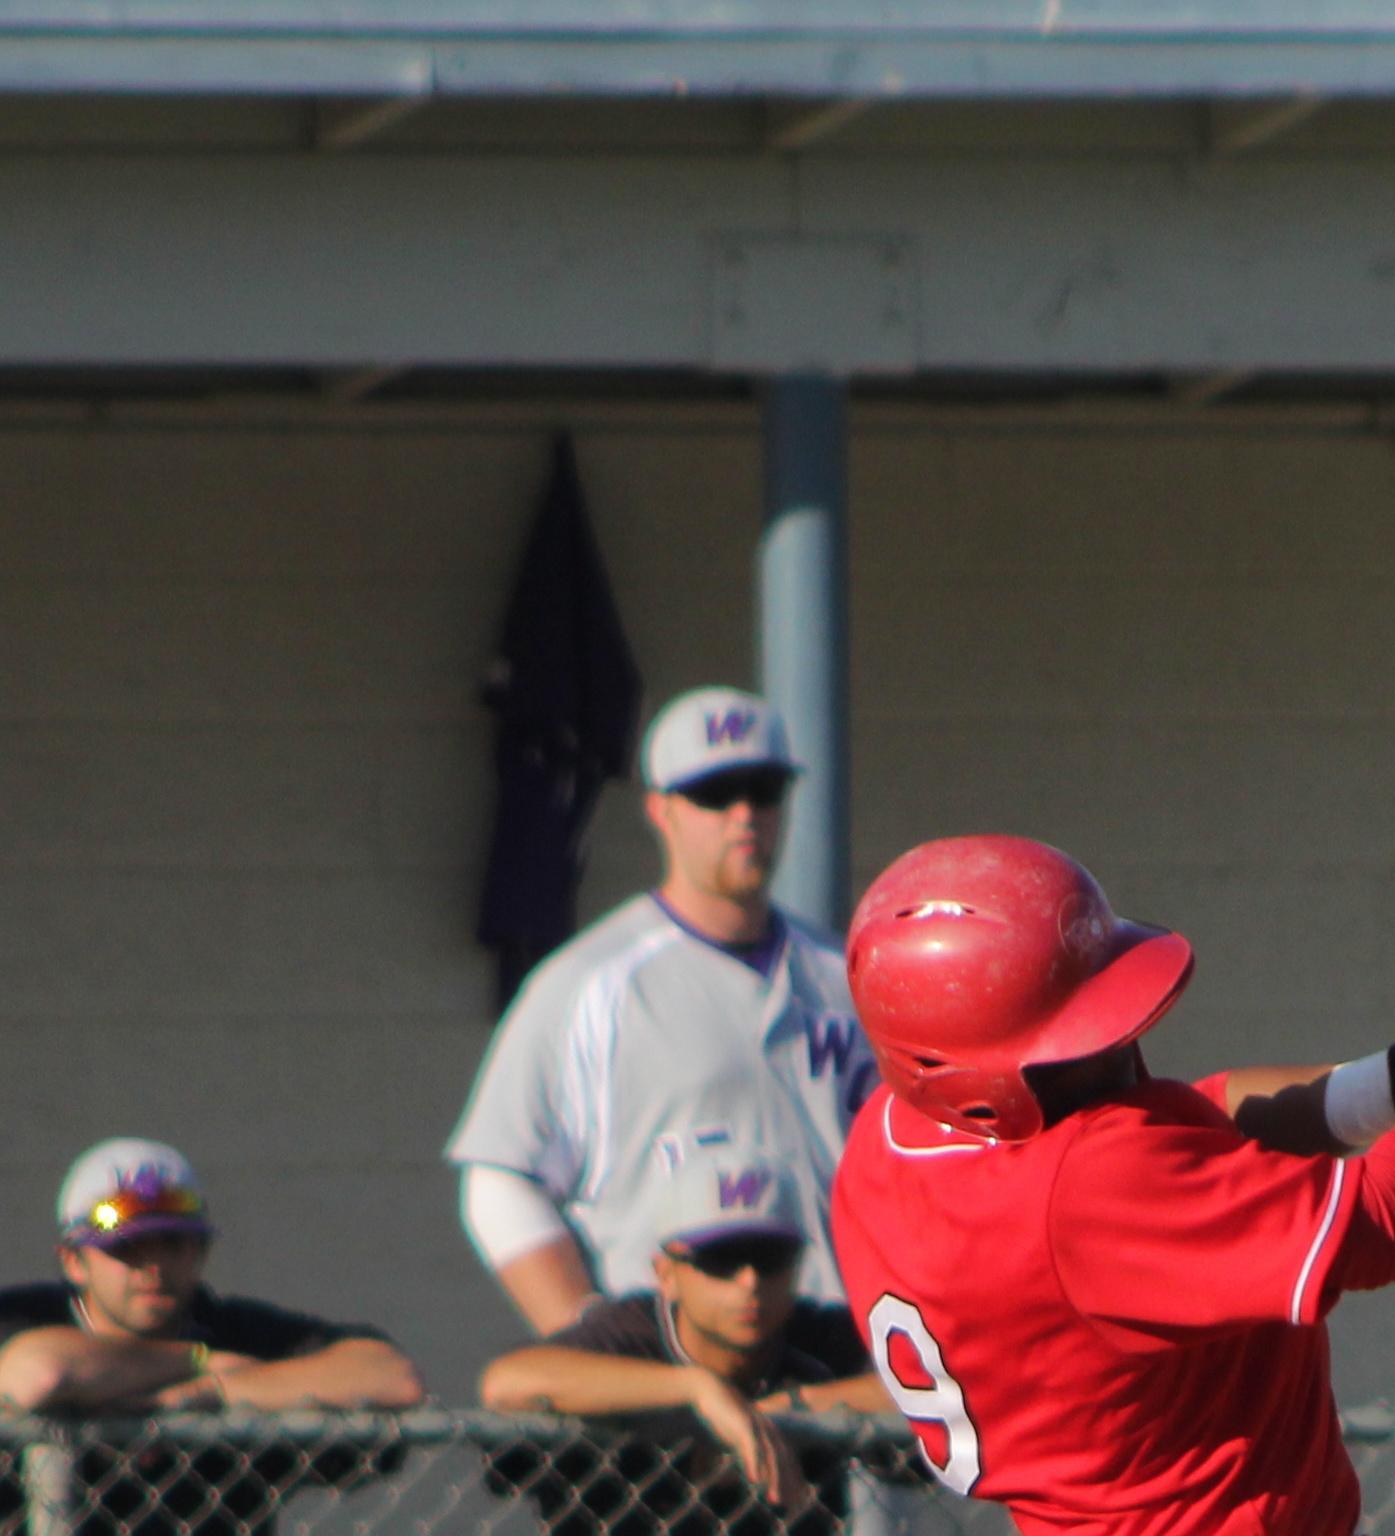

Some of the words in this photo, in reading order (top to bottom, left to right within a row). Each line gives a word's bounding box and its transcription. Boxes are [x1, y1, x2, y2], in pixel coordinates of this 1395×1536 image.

[704, 709, 757, 747] W
[715, 1166, 773, 1210] W
[868, 1291, 982, 1497] 9
